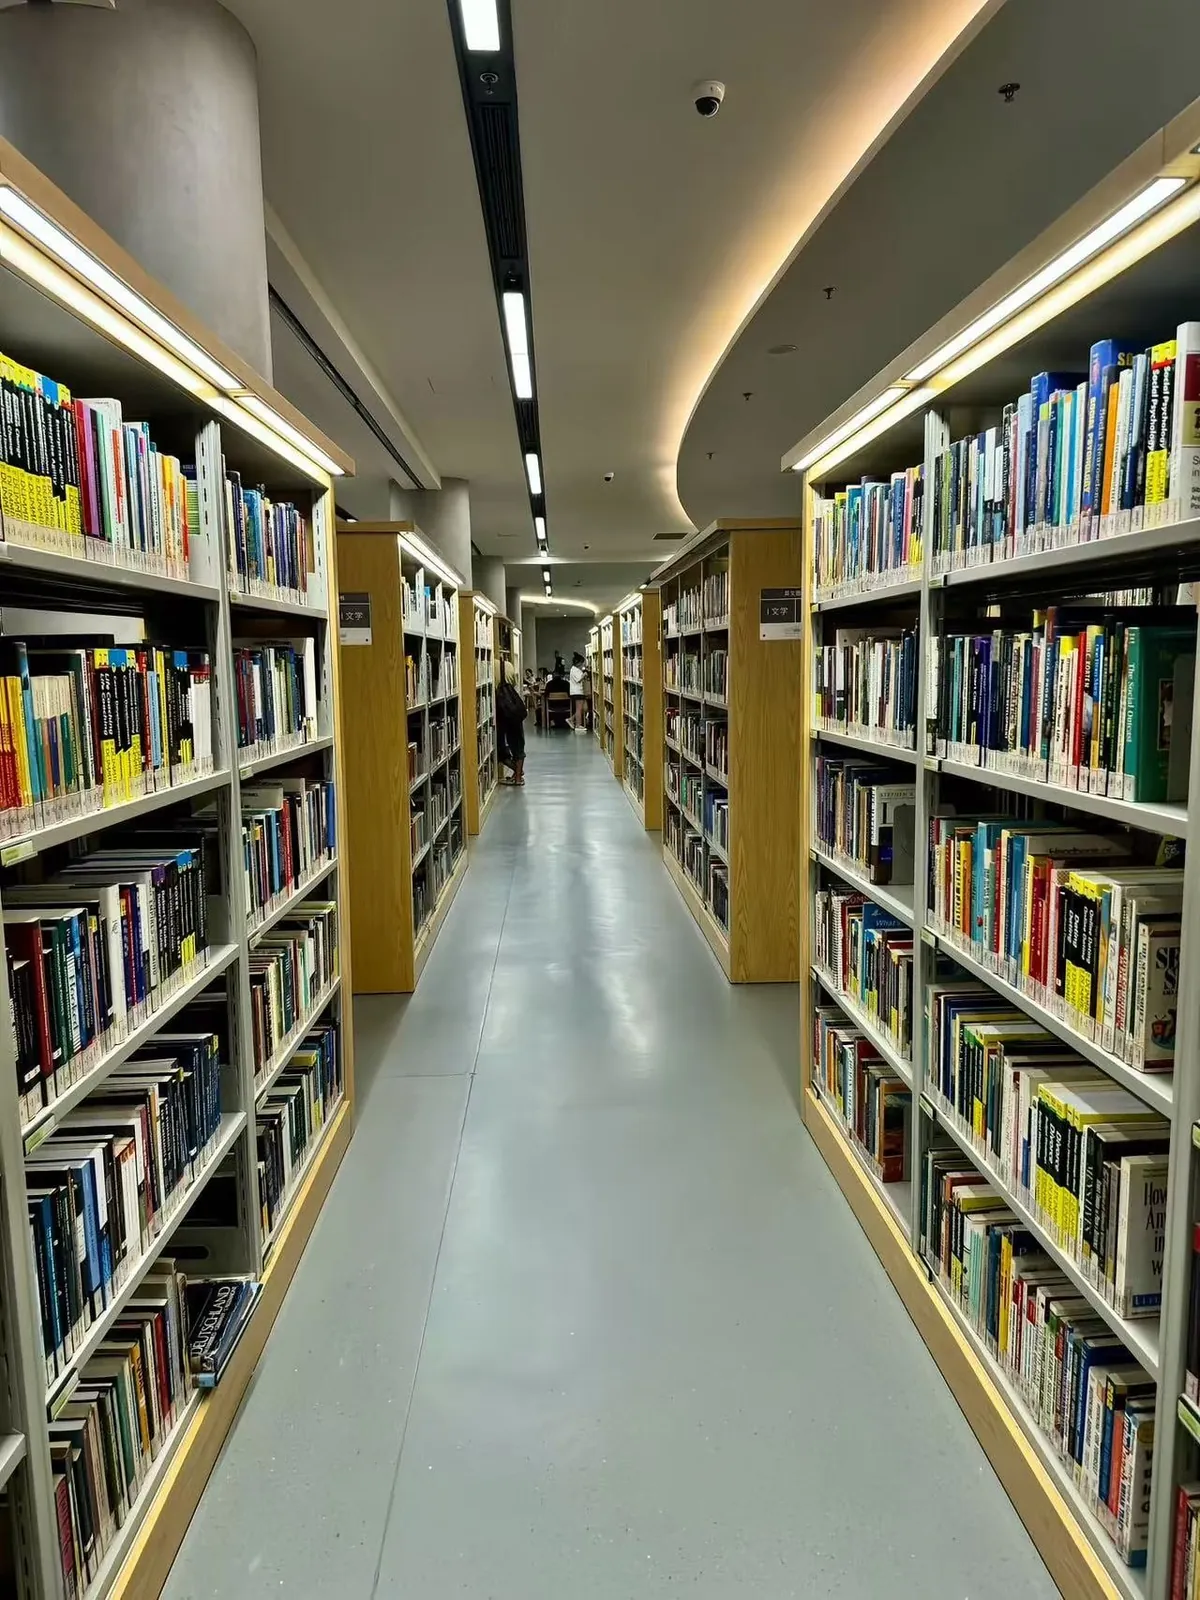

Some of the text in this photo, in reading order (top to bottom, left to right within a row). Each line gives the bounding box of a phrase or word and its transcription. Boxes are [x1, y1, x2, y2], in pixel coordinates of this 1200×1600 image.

[48, 414, 56, 458] Enterprise
[1083, 397, 1096, 493] SOCIAL PSYCHOLOGY
[1148, 399, 1158, 451] Psychology
[1160, 396, 1169, 449] Psychology
[1094, 409, 1106, 510] Social Neuroscience
[346, 612, 364, 620] 文学
[772, 607, 788, 616] 文学
[69, 975, 78, 1031] Hooked
[191, 1286, 230, 1358] DEUTSCHLAND
